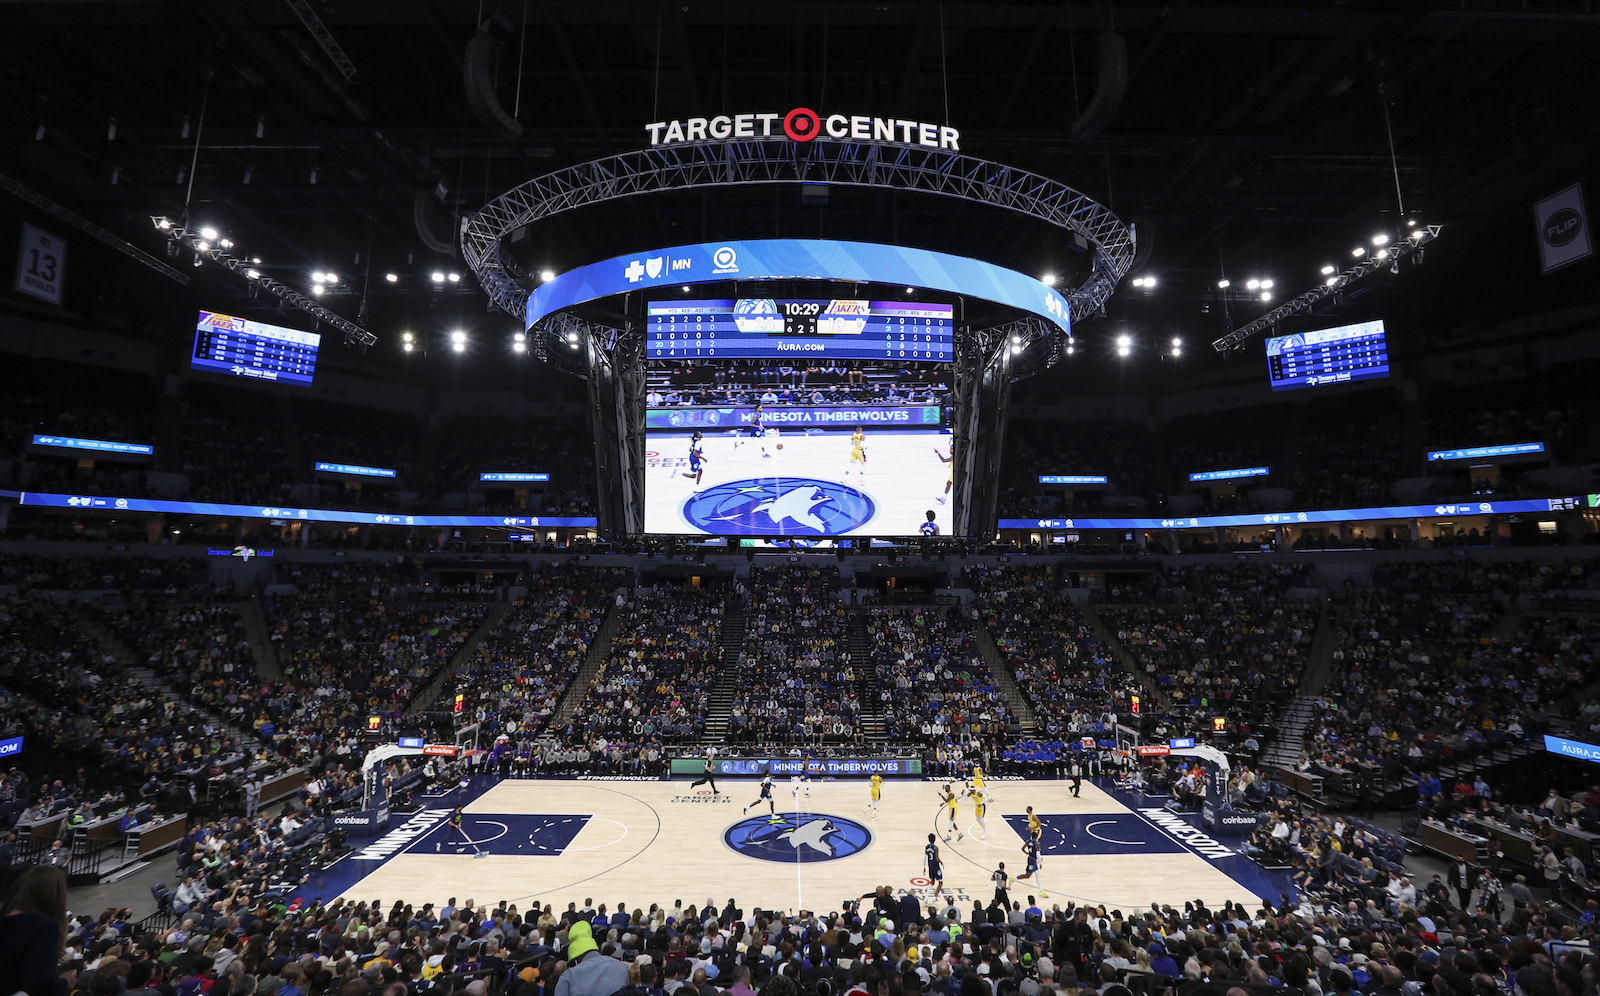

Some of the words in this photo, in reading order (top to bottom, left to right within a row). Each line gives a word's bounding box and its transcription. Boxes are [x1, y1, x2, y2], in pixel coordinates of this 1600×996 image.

[645, 113, 779, 145] TARGET
[825, 114, 960, 151] CENTER
[1547, 217, 1578, 238] FLIP
[27, 248, 57, 282] 13
[672, 258, 691, 271] MN
[785, 303, 820, 316] 10:29
[798, 325, 804, 333] 2
[777, 342, 824, 351] ĀURA.COM
[741, 412, 813, 422] MNNESOTA
[814, 411, 909, 422] TIMBERWOLVES
[454, 701, 463, 712] 21
[1131, 702, 1140, 713] 21
[334, 816, 369, 824] coinbase
[1222, 816, 1256, 824] coinbase
[928, 852, 934, 860] 3
